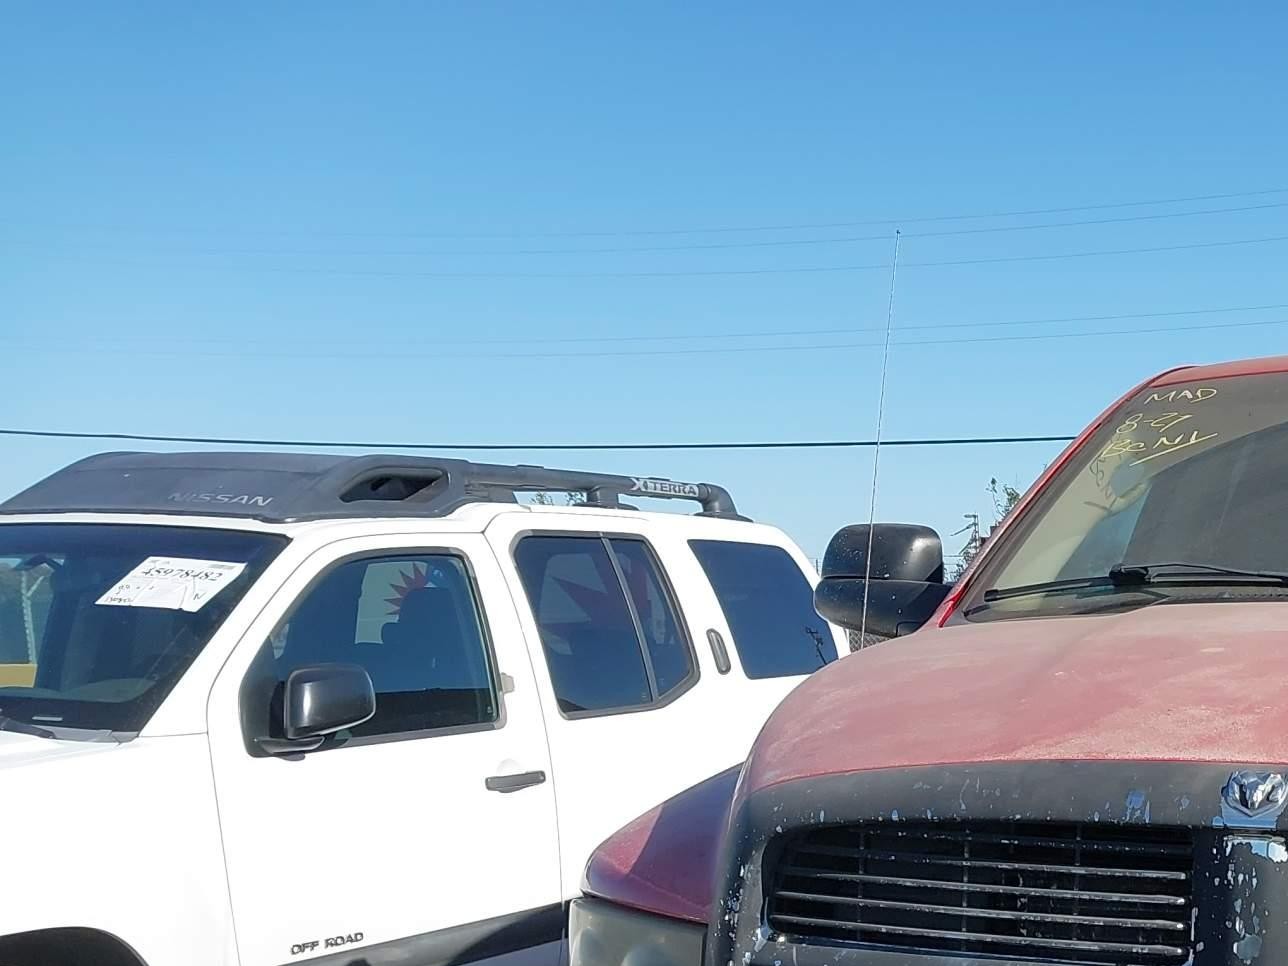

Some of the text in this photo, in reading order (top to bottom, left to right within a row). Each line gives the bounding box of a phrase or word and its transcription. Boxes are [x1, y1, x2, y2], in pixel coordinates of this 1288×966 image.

[1143, 388, 1217, 405] MAD
[168, 493, 274, 506] NISSAN
[291, 932, 364, 955] OFF ROAD
